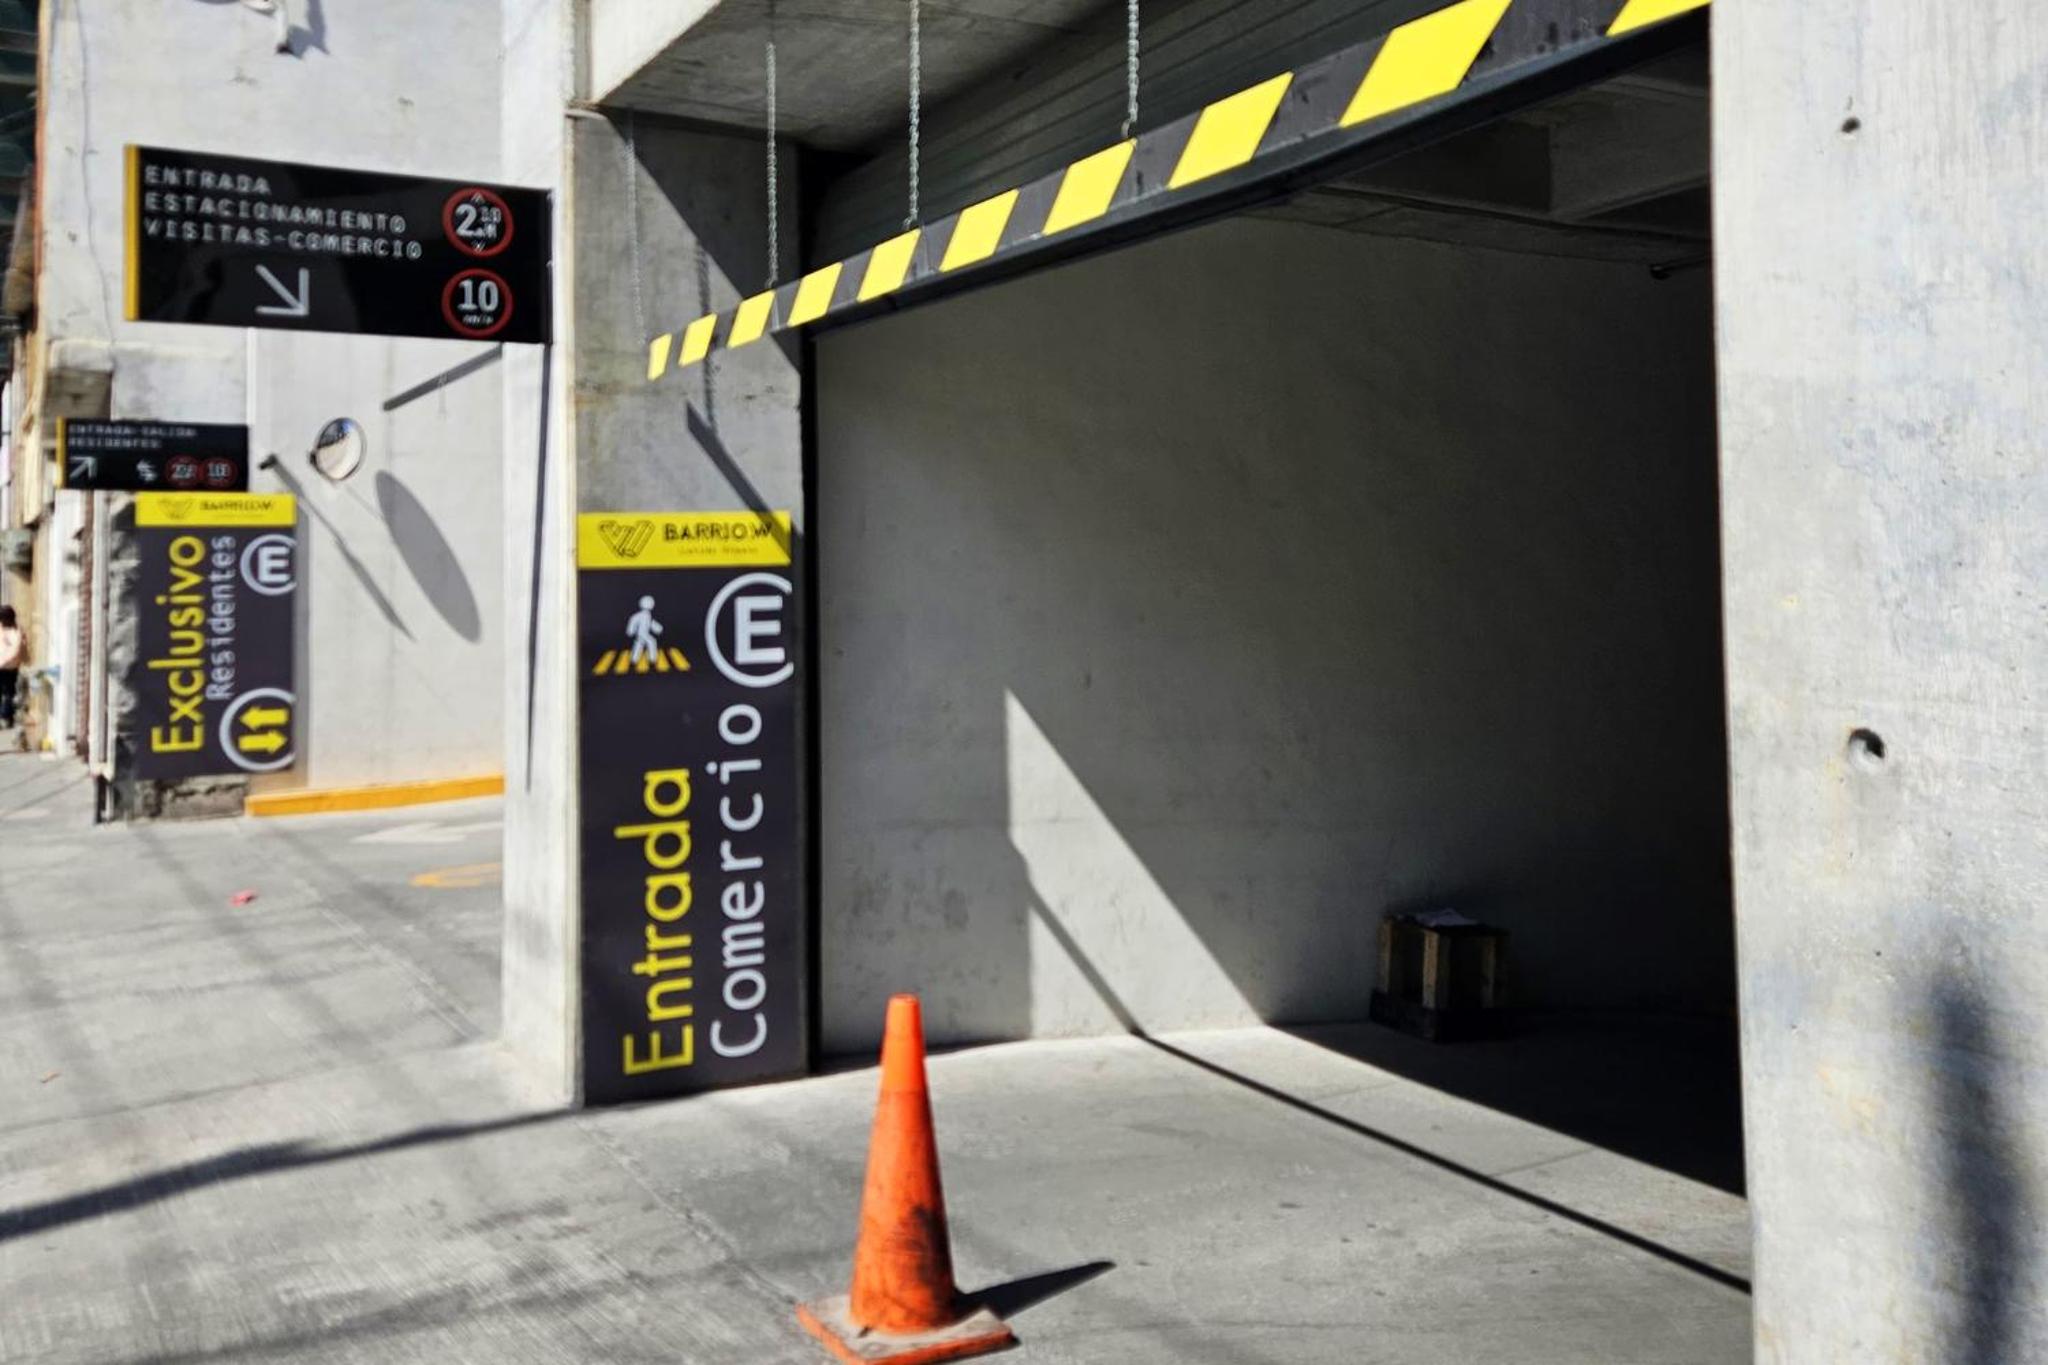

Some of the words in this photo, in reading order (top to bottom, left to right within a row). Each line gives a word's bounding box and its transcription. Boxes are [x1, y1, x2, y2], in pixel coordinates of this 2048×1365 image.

[145, 165, 271, 194] ENTRADA
[145, 192, 406, 234] ESTACIONAMIENTO
[458, 278, 499, 313] 10
[148, 535, 205, 753] Exclusivo
[206, 535, 236, 701] Residentes
[733, 595, 785, 665] E
[614, 768, 694, 1075] Entrada
[706, 703, 768, 1058] Comercio
